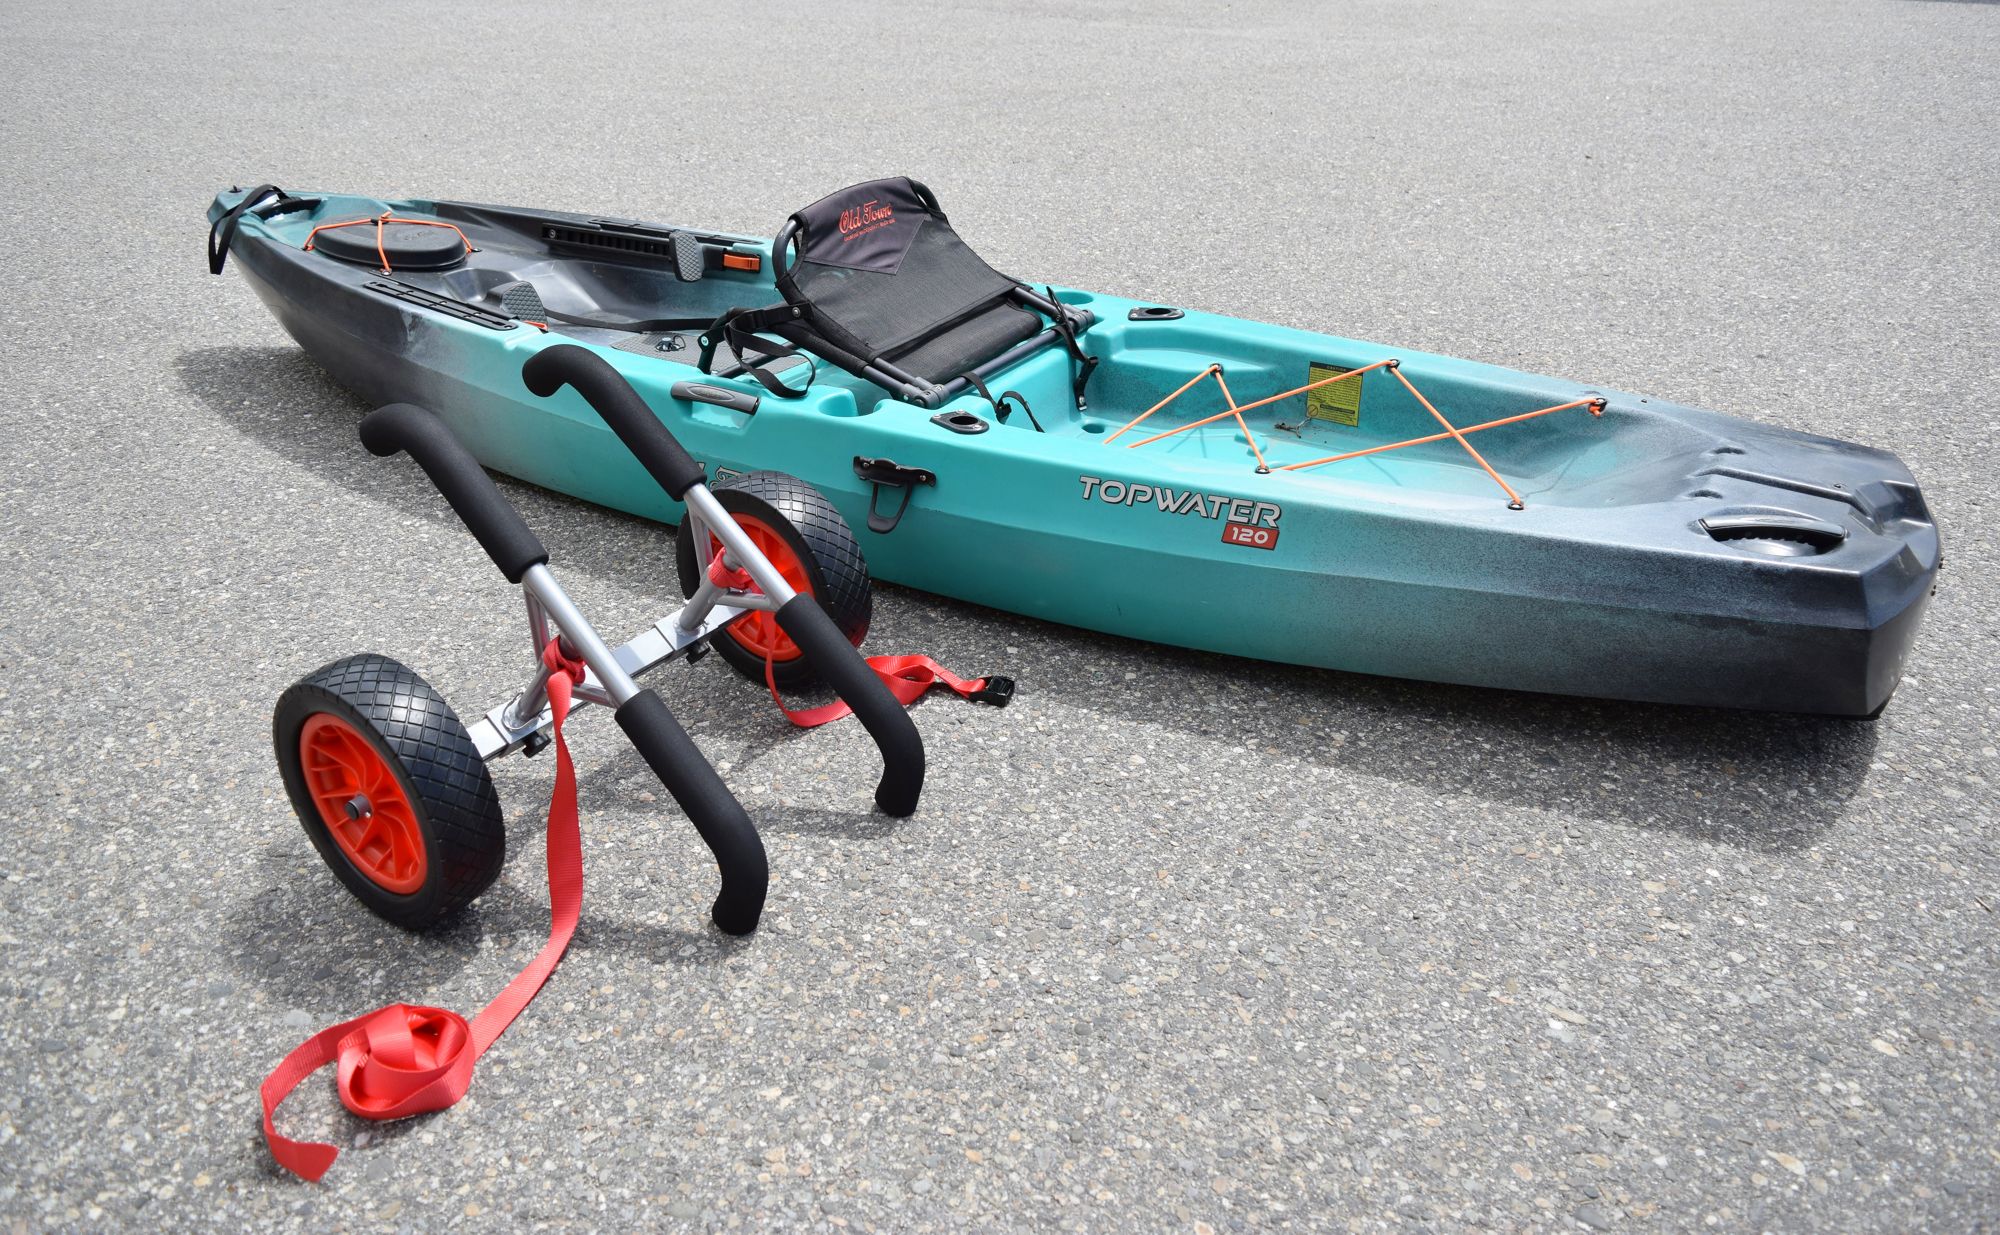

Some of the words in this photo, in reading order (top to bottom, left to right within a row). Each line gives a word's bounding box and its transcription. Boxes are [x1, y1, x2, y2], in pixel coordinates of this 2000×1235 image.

[839, 206, 862, 234] Old
[862, 200, 893, 225] Town
[1079, 475, 1282, 529] TOPWATER
[1231, 526, 1269, 545] 120
